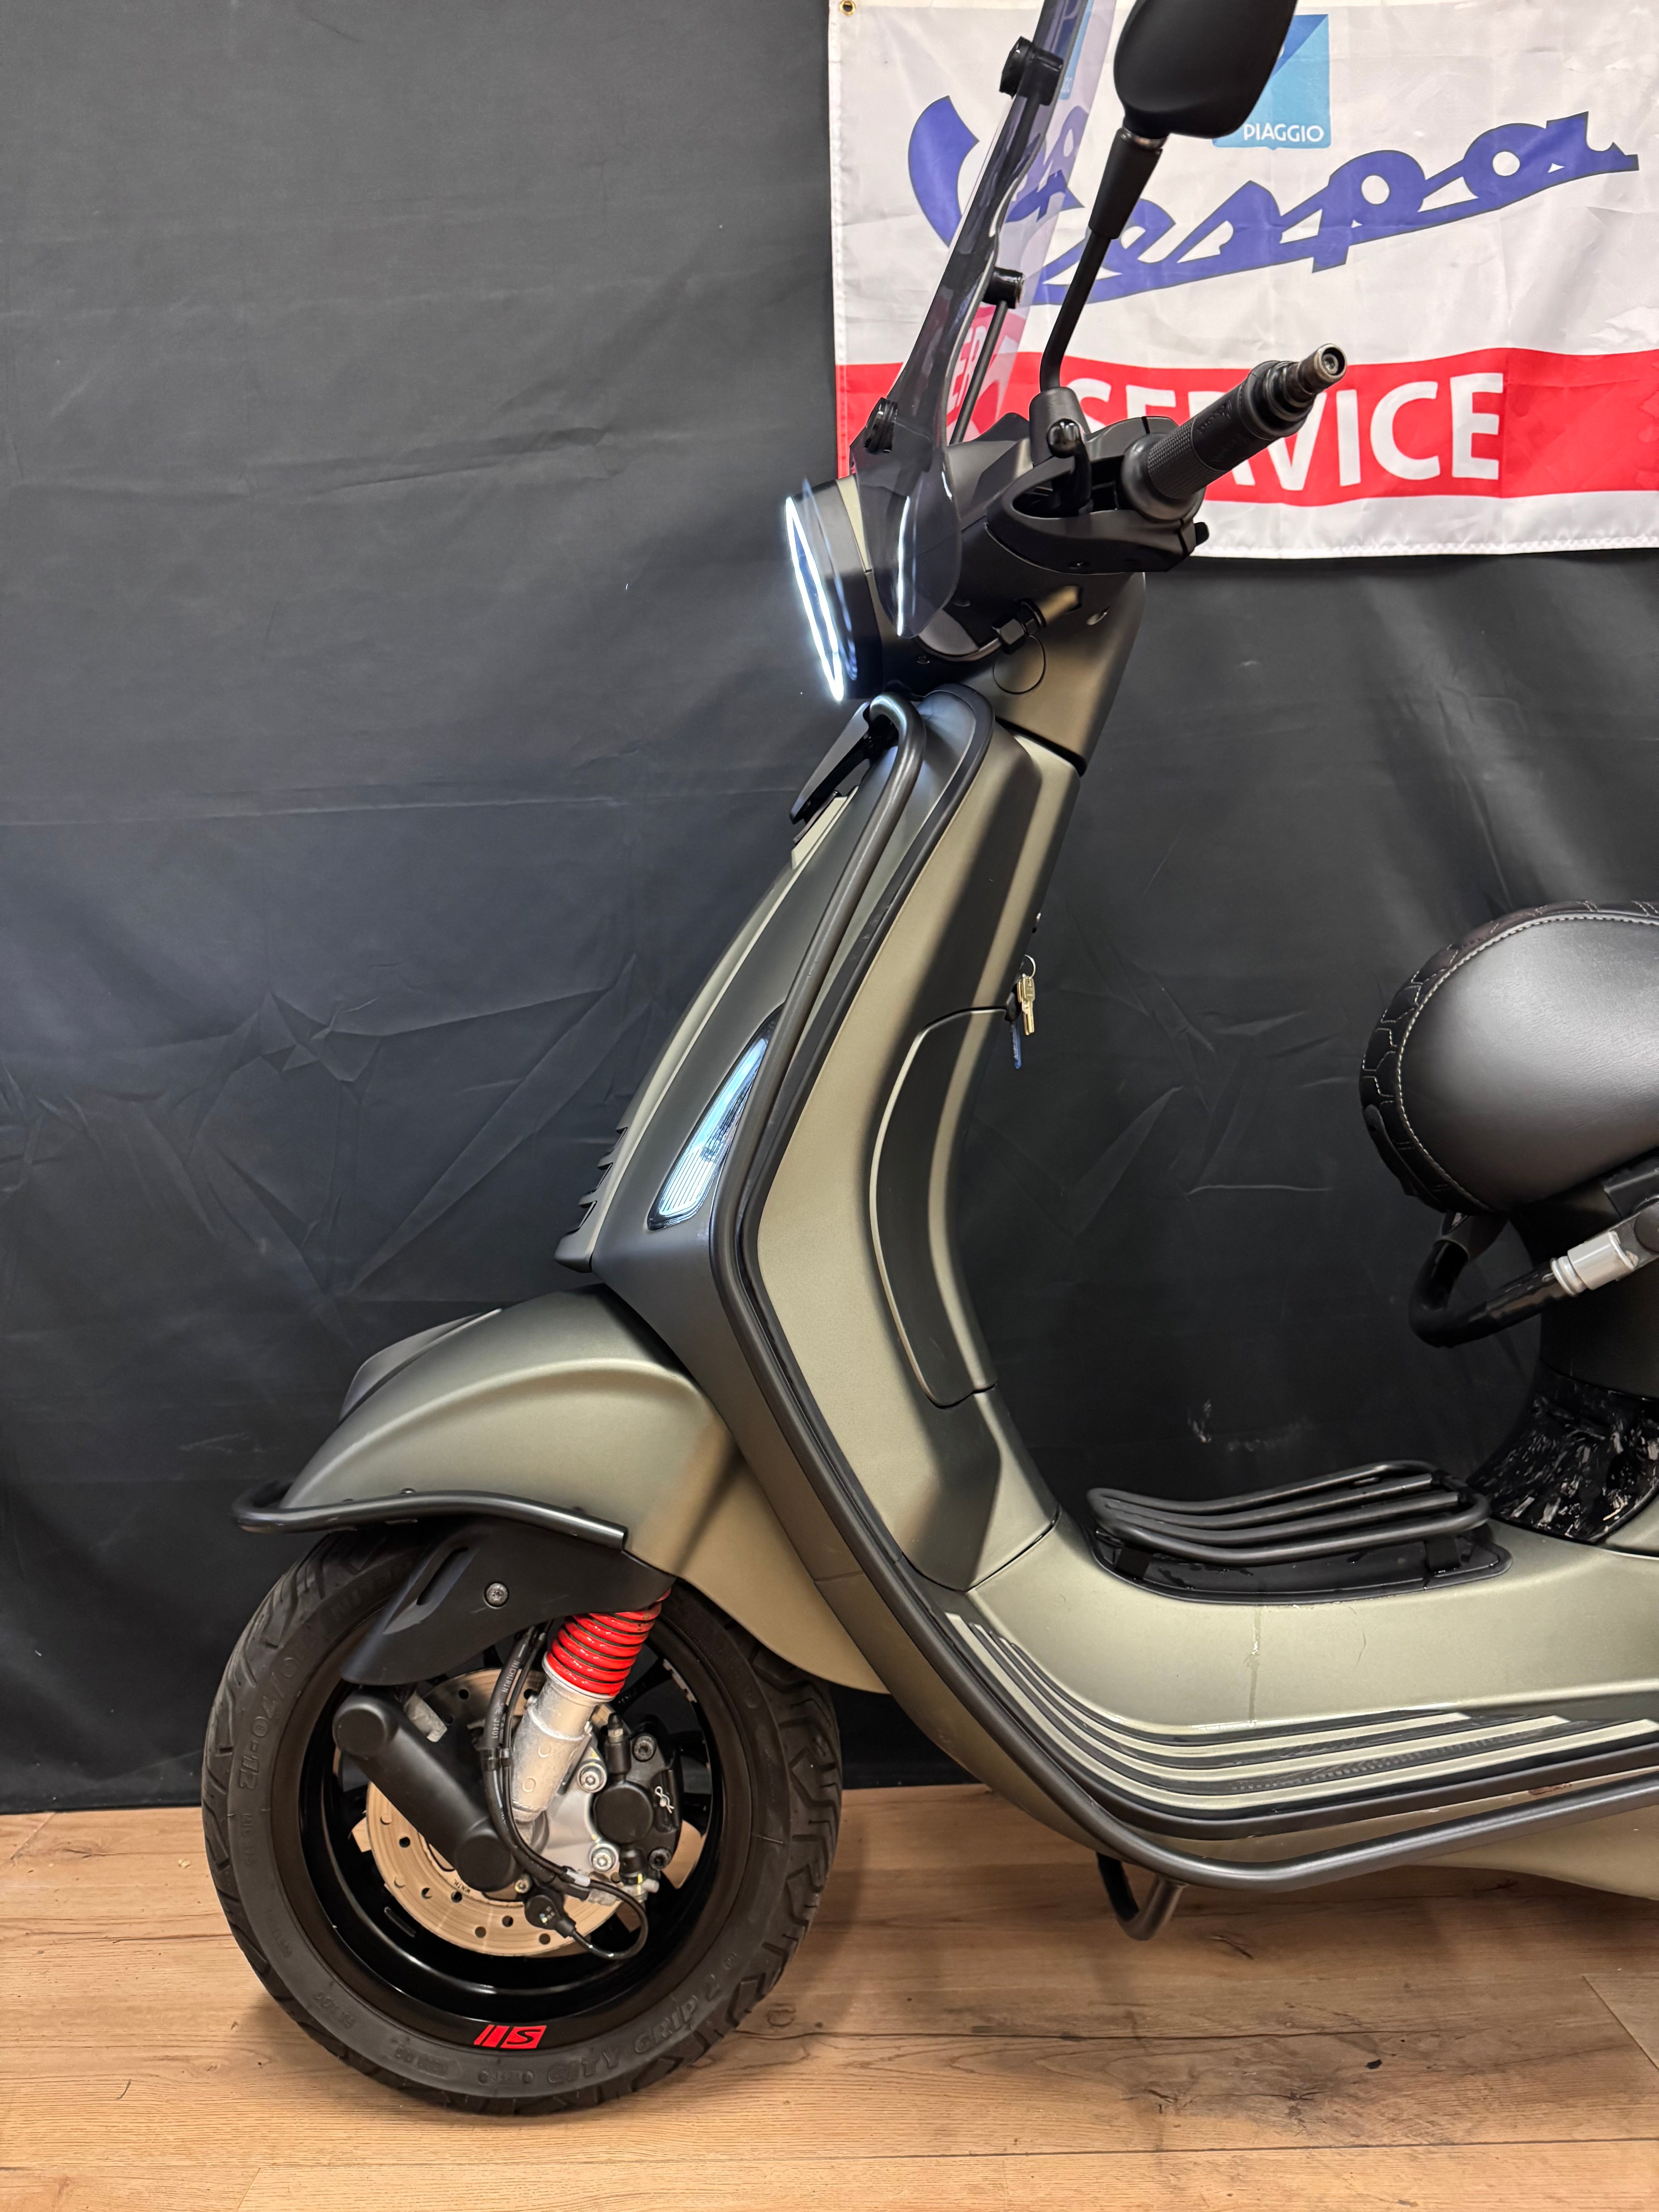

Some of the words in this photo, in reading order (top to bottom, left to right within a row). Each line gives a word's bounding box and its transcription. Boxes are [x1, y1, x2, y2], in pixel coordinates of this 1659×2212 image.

[1243, 123, 1324, 142] PIAGGIO
[501, 1660, 520, 1693] NICHIRIN
[495, 1702, 505, 1715] SAE
[491, 1718, 501, 1739] J1401
[548, 2049, 620, 2084] CITY
[634, 1995, 698, 2054] GRIP
